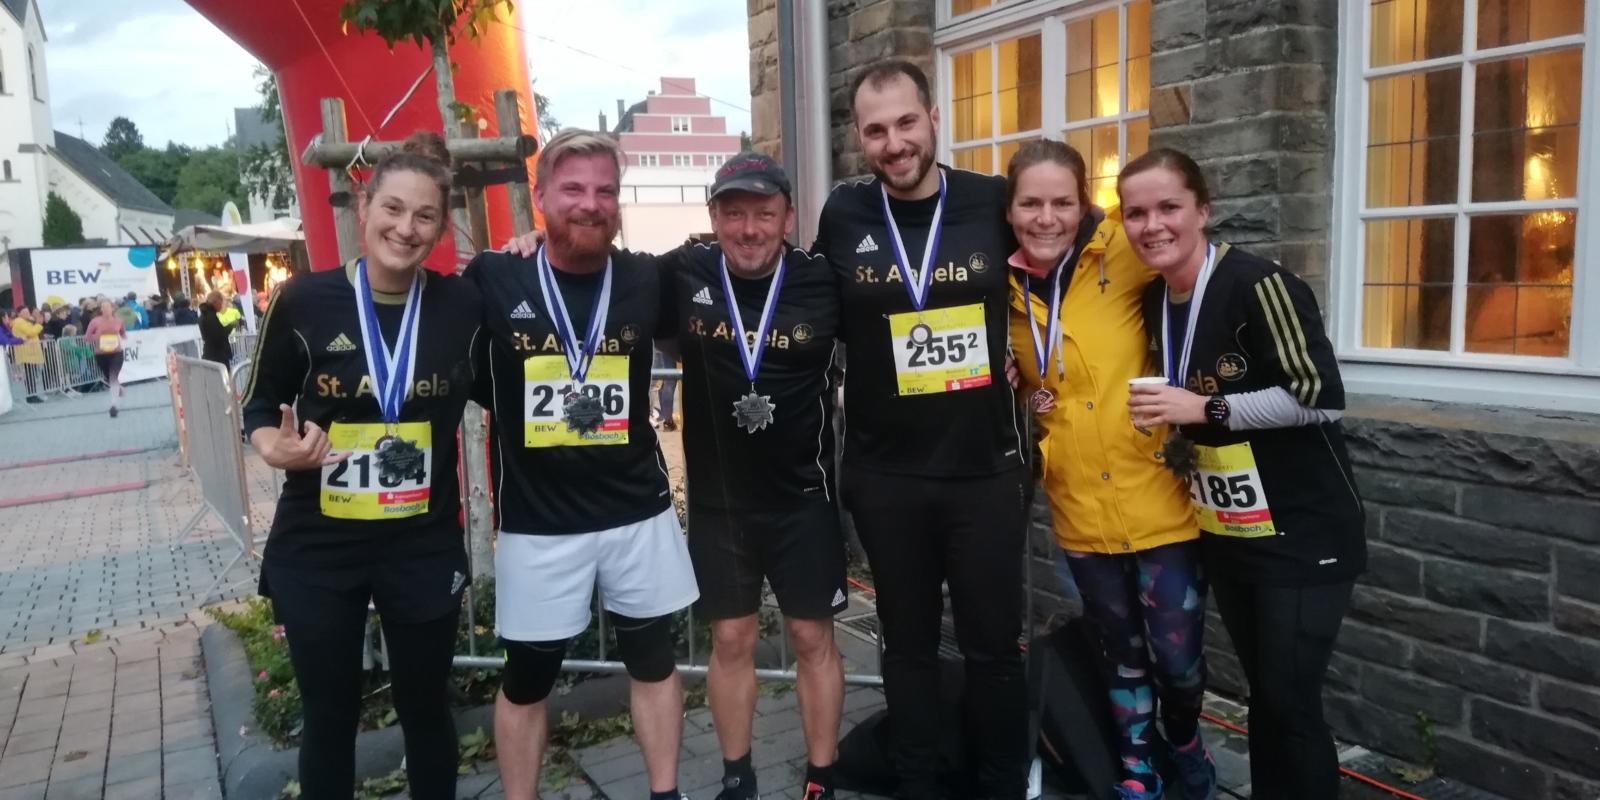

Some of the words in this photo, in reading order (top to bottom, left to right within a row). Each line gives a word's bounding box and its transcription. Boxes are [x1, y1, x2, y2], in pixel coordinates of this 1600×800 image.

[856, 244, 879, 253] adidas
[47, 269, 101, 285] BEW
[856, 265, 879, 283] St.
[886, 262, 968, 286] Anela
[693, 296, 713, 305] adidas
[688, 316, 706, 336] St.
[326, 344, 357, 352] adidas
[125, 347, 138, 362] EW
[317, 374, 347, 398] St.
[355, 373, 450, 400] Aela
[535, 425, 557, 433] BEW
[329, 494, 351, 503] BEW
